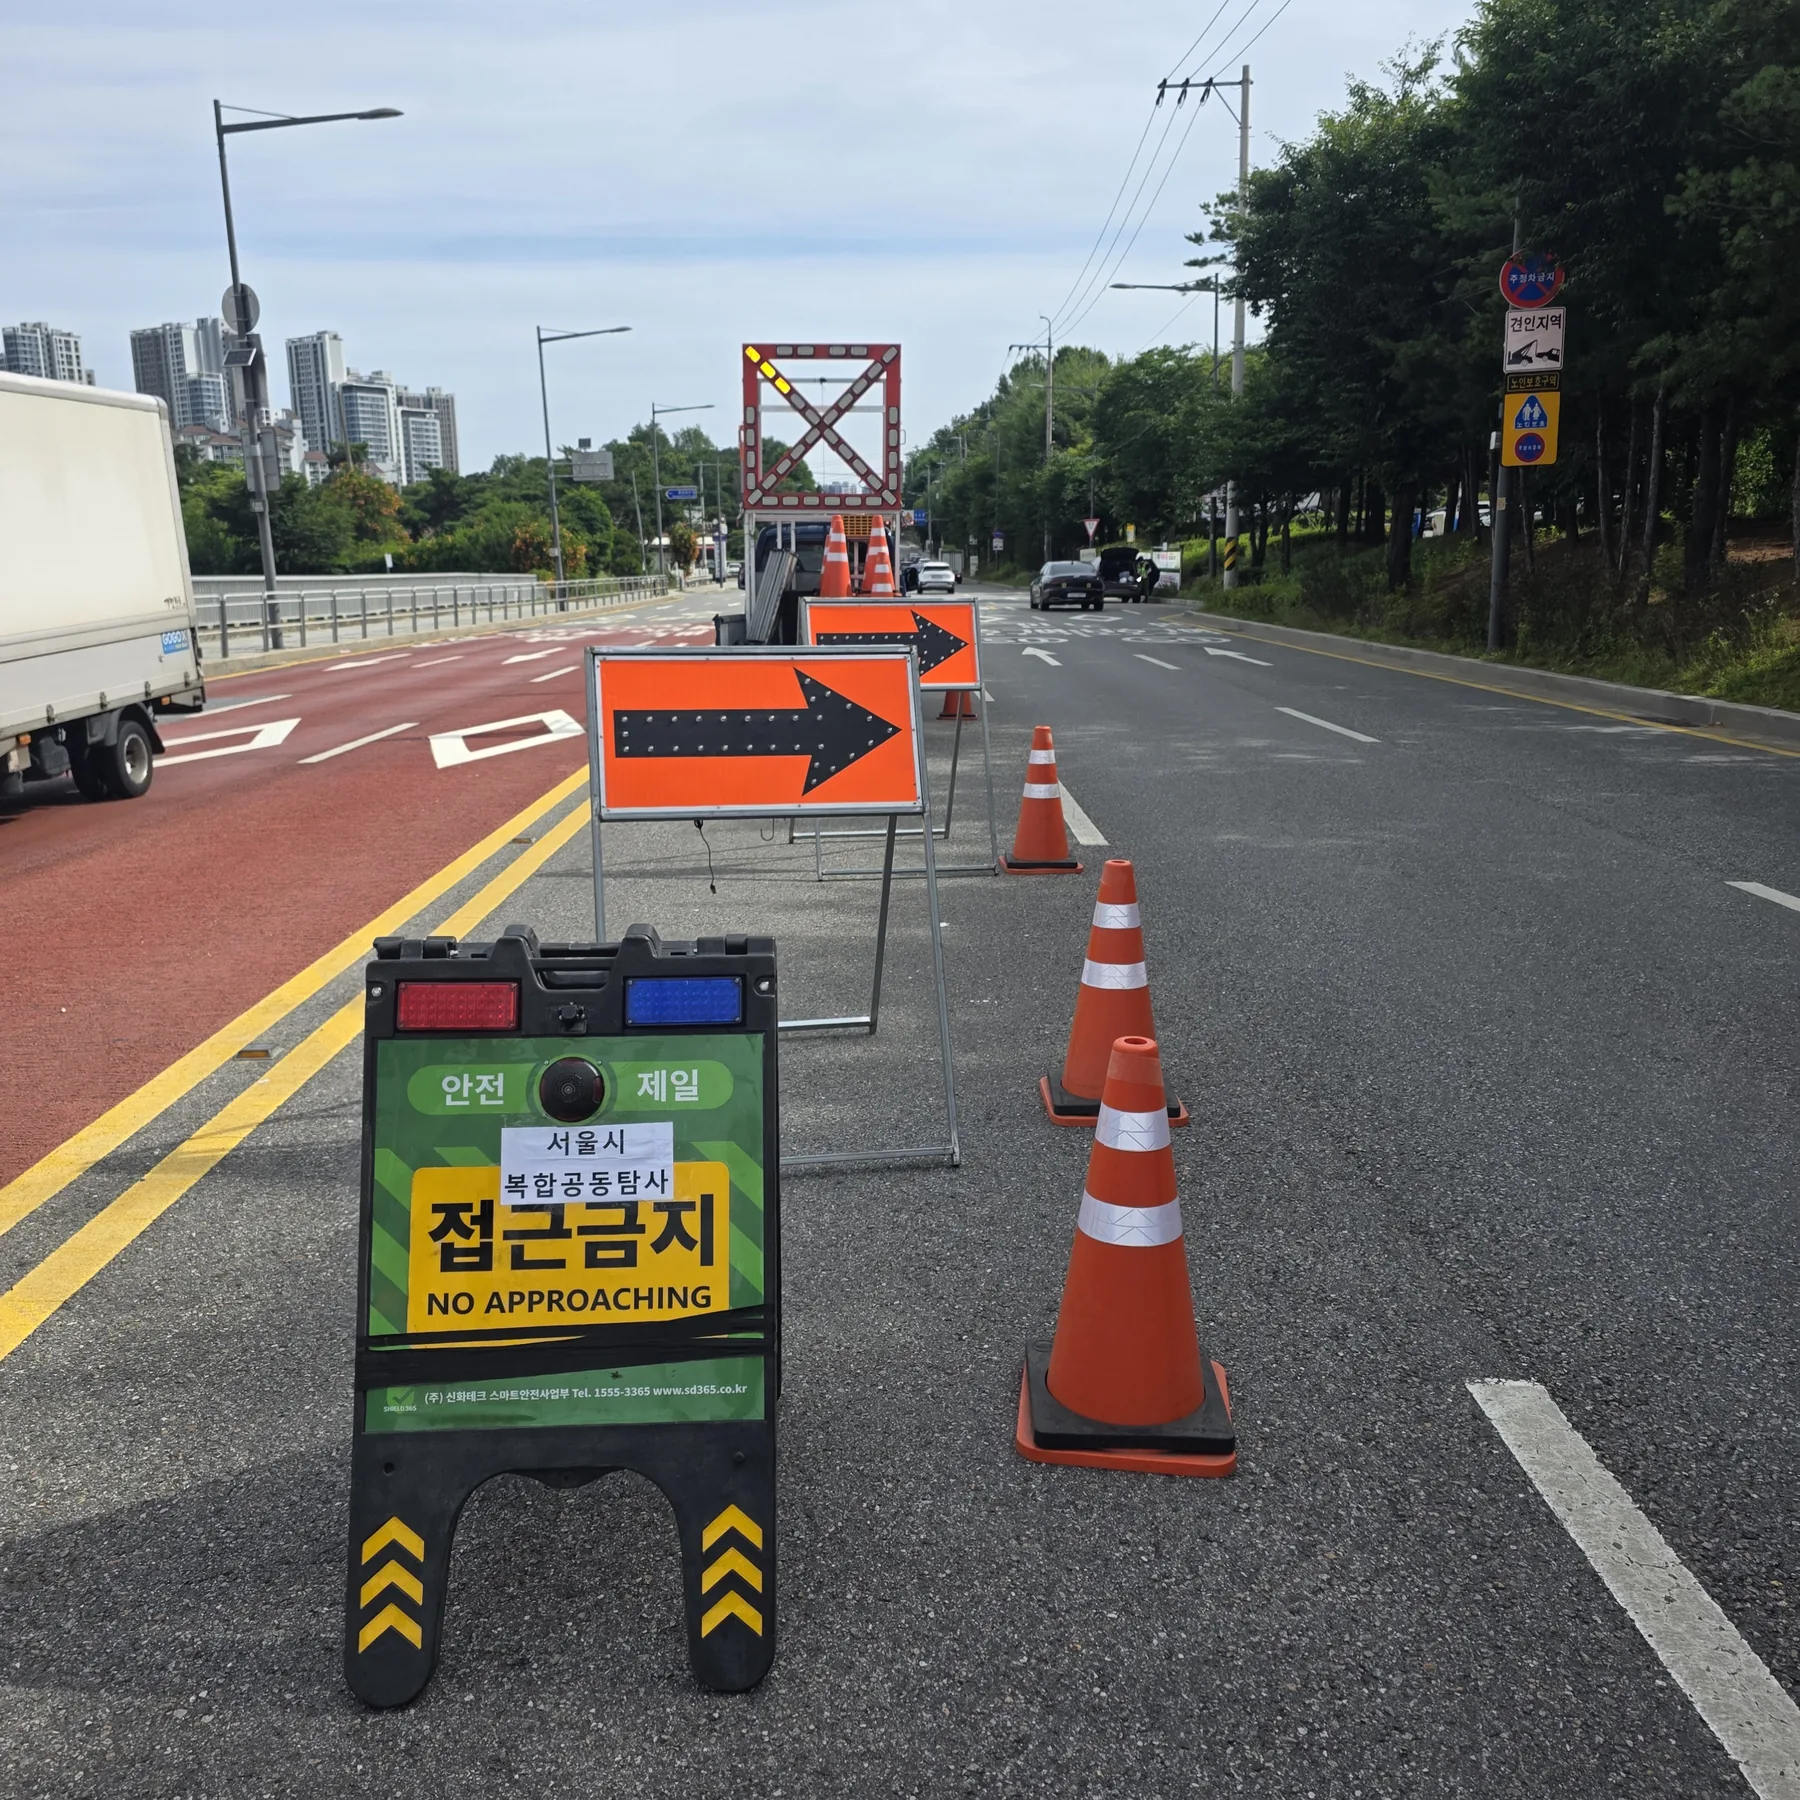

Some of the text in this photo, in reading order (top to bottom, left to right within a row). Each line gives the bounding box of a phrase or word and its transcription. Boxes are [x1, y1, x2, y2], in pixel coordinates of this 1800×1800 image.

[1509, 272, 1555, 283] 주정차금지
[1510, 313, 1562, 333] 견인지역
[1510, 375, 1557, 389] 노인보호구역
[441, 1069, 700, 1106] 안전 제일
[547, 1129, 626, 1156] 서울시
[504, 1168, 669, 1199] 복합공동탐사
[428, 1194, 715, 1273] 접근금지
[427, 1285, 712, 1316] NO APPROACHING
[424, 1383, 748, 1405] (주) 신화테크 스마트안전사업부 Tel. 1555-3365 www.sd365.co.kr
